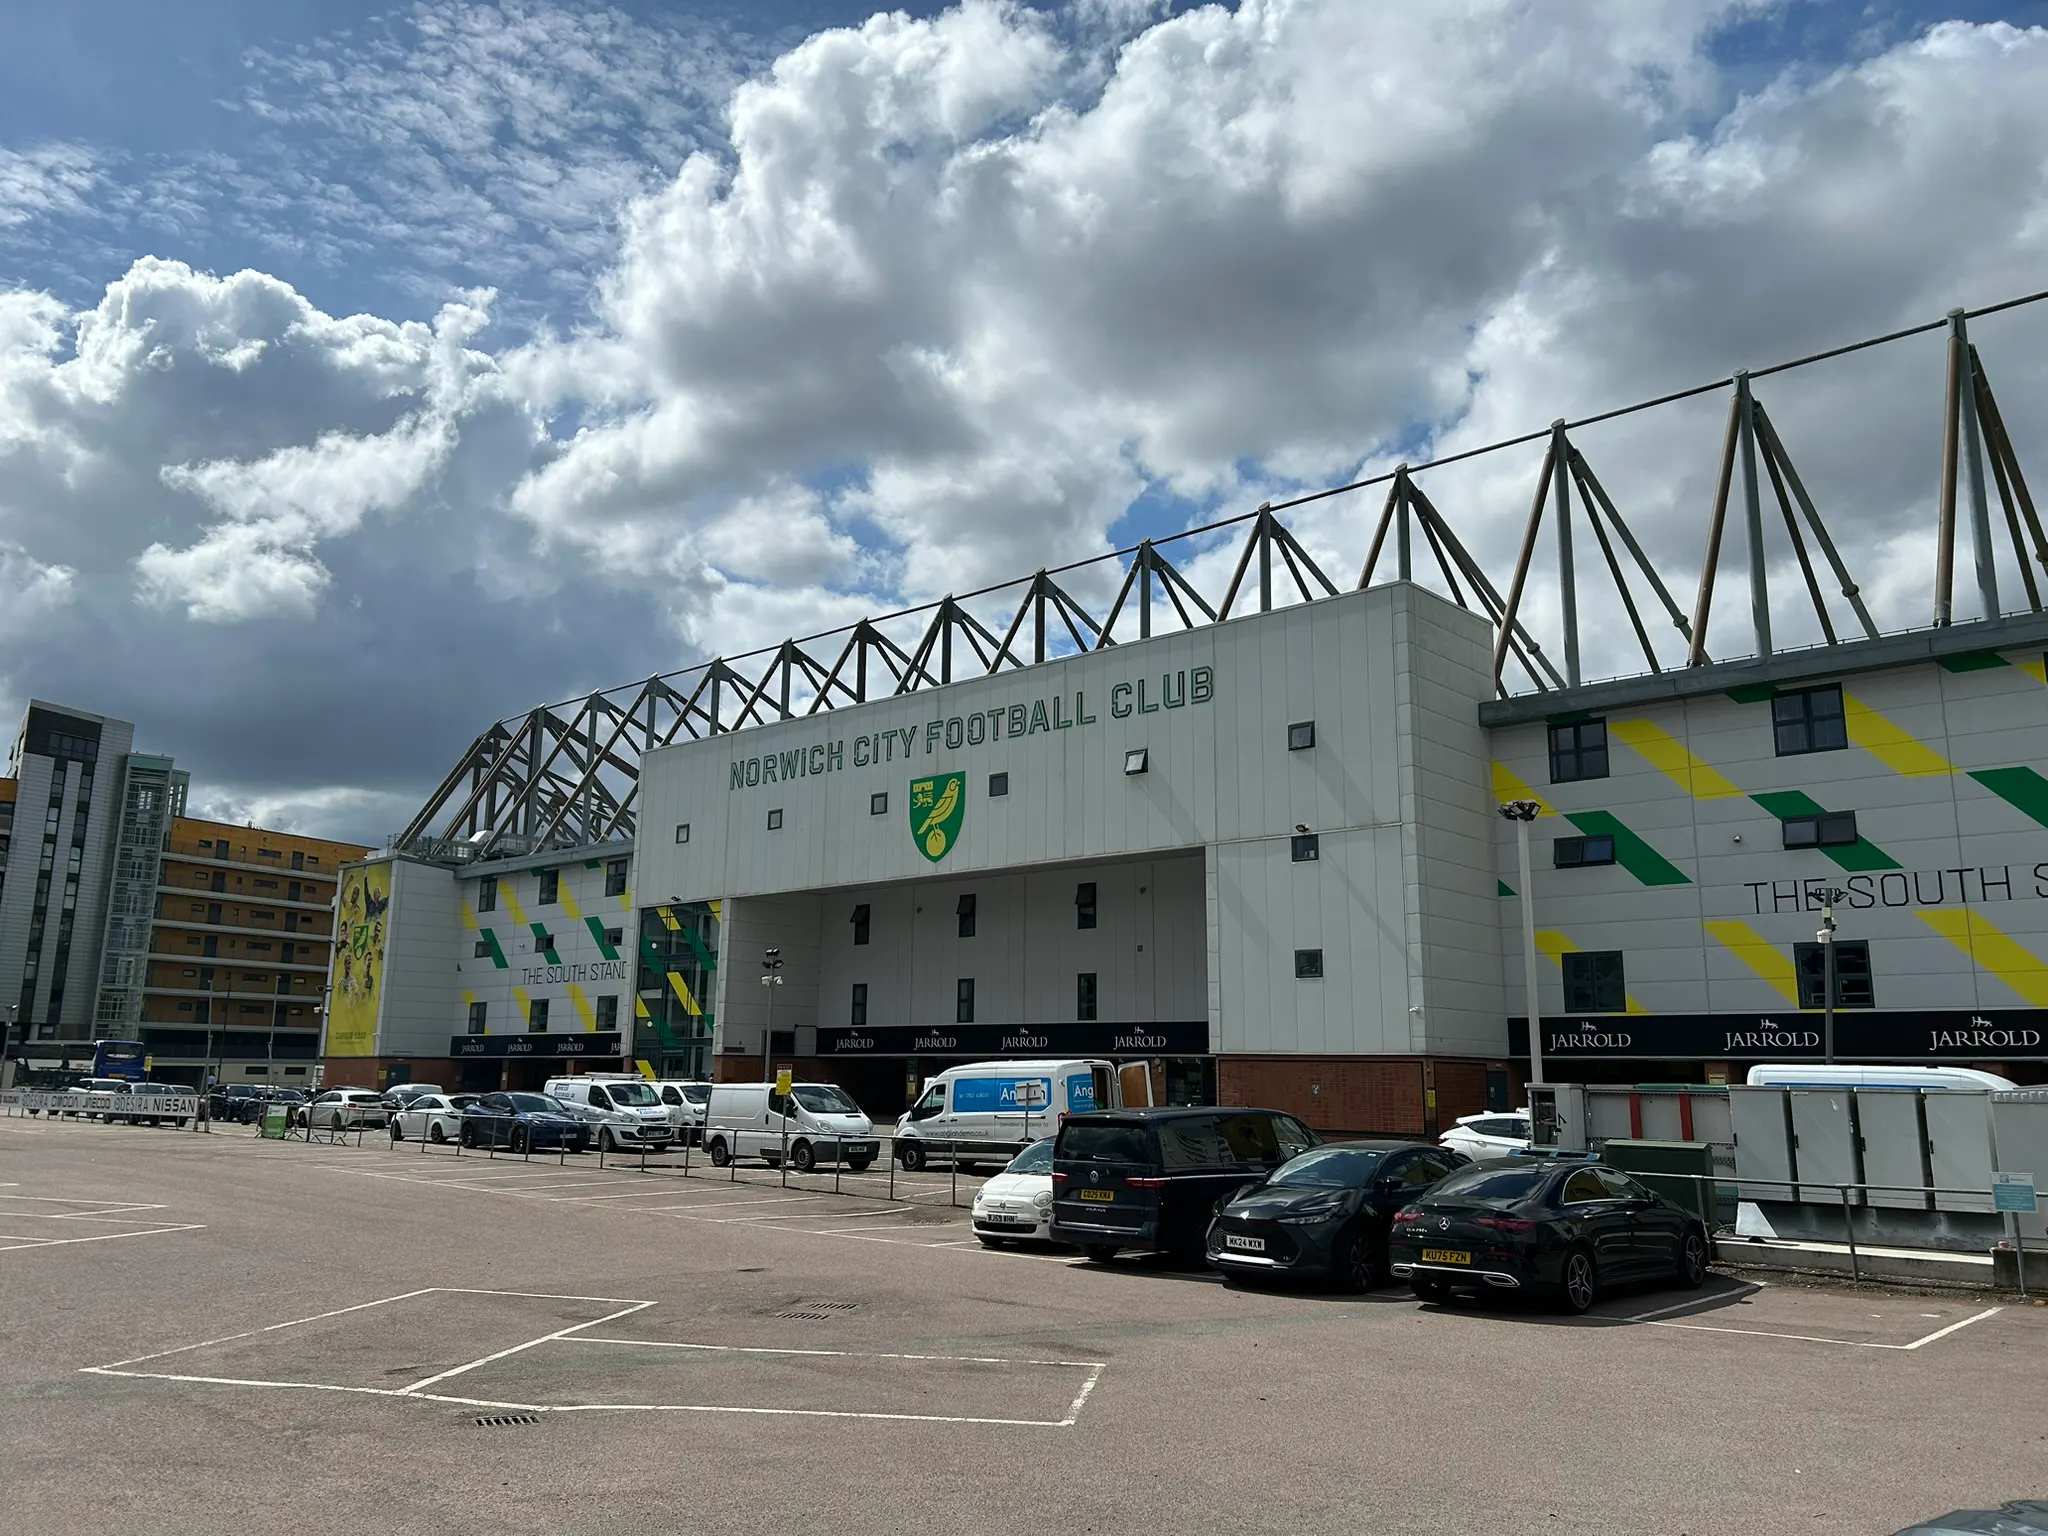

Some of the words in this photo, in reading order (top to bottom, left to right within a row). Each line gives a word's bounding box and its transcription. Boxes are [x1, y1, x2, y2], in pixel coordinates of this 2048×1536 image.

[730, 740, 843, 790] NORWICH
[853, 725, 917, 767] CITY
[926, 692, 1096, 753] FOOTBALL
[1111, 665, 1213, 719] CLUB
[1743, 878, 1827, 914] THE
[1847, 865, 2012, 909] SOUTH
[522, 967, 543, 984] THE
[546, 964, 587, 984] SOUTH
[835, 1038, 874, 1051] JARROLD
[914, 1037, 957, 1050] JARROLD
[1001, 1036, 1048, 1050] JARROLD
[1113, 1035, 1167, 1050] JARROLD
[1550, 1033, 1631, 1051] JARROLD
[1724, 1032, 1819, 1051] JARROLD
[1929, 1030, 2040, 1051] JARROLD
[461, 1044, 485, 1054] JARROLD
[507, 1043, 533, 1054] JARROLD
[556, 1043, 584, 1054] JARROLD
[152, 1098, 195, 1113] NISSAN
[1425, 1250, 1447, 1261] KU75
[1449, 1251, 1467, 1262] FZN
